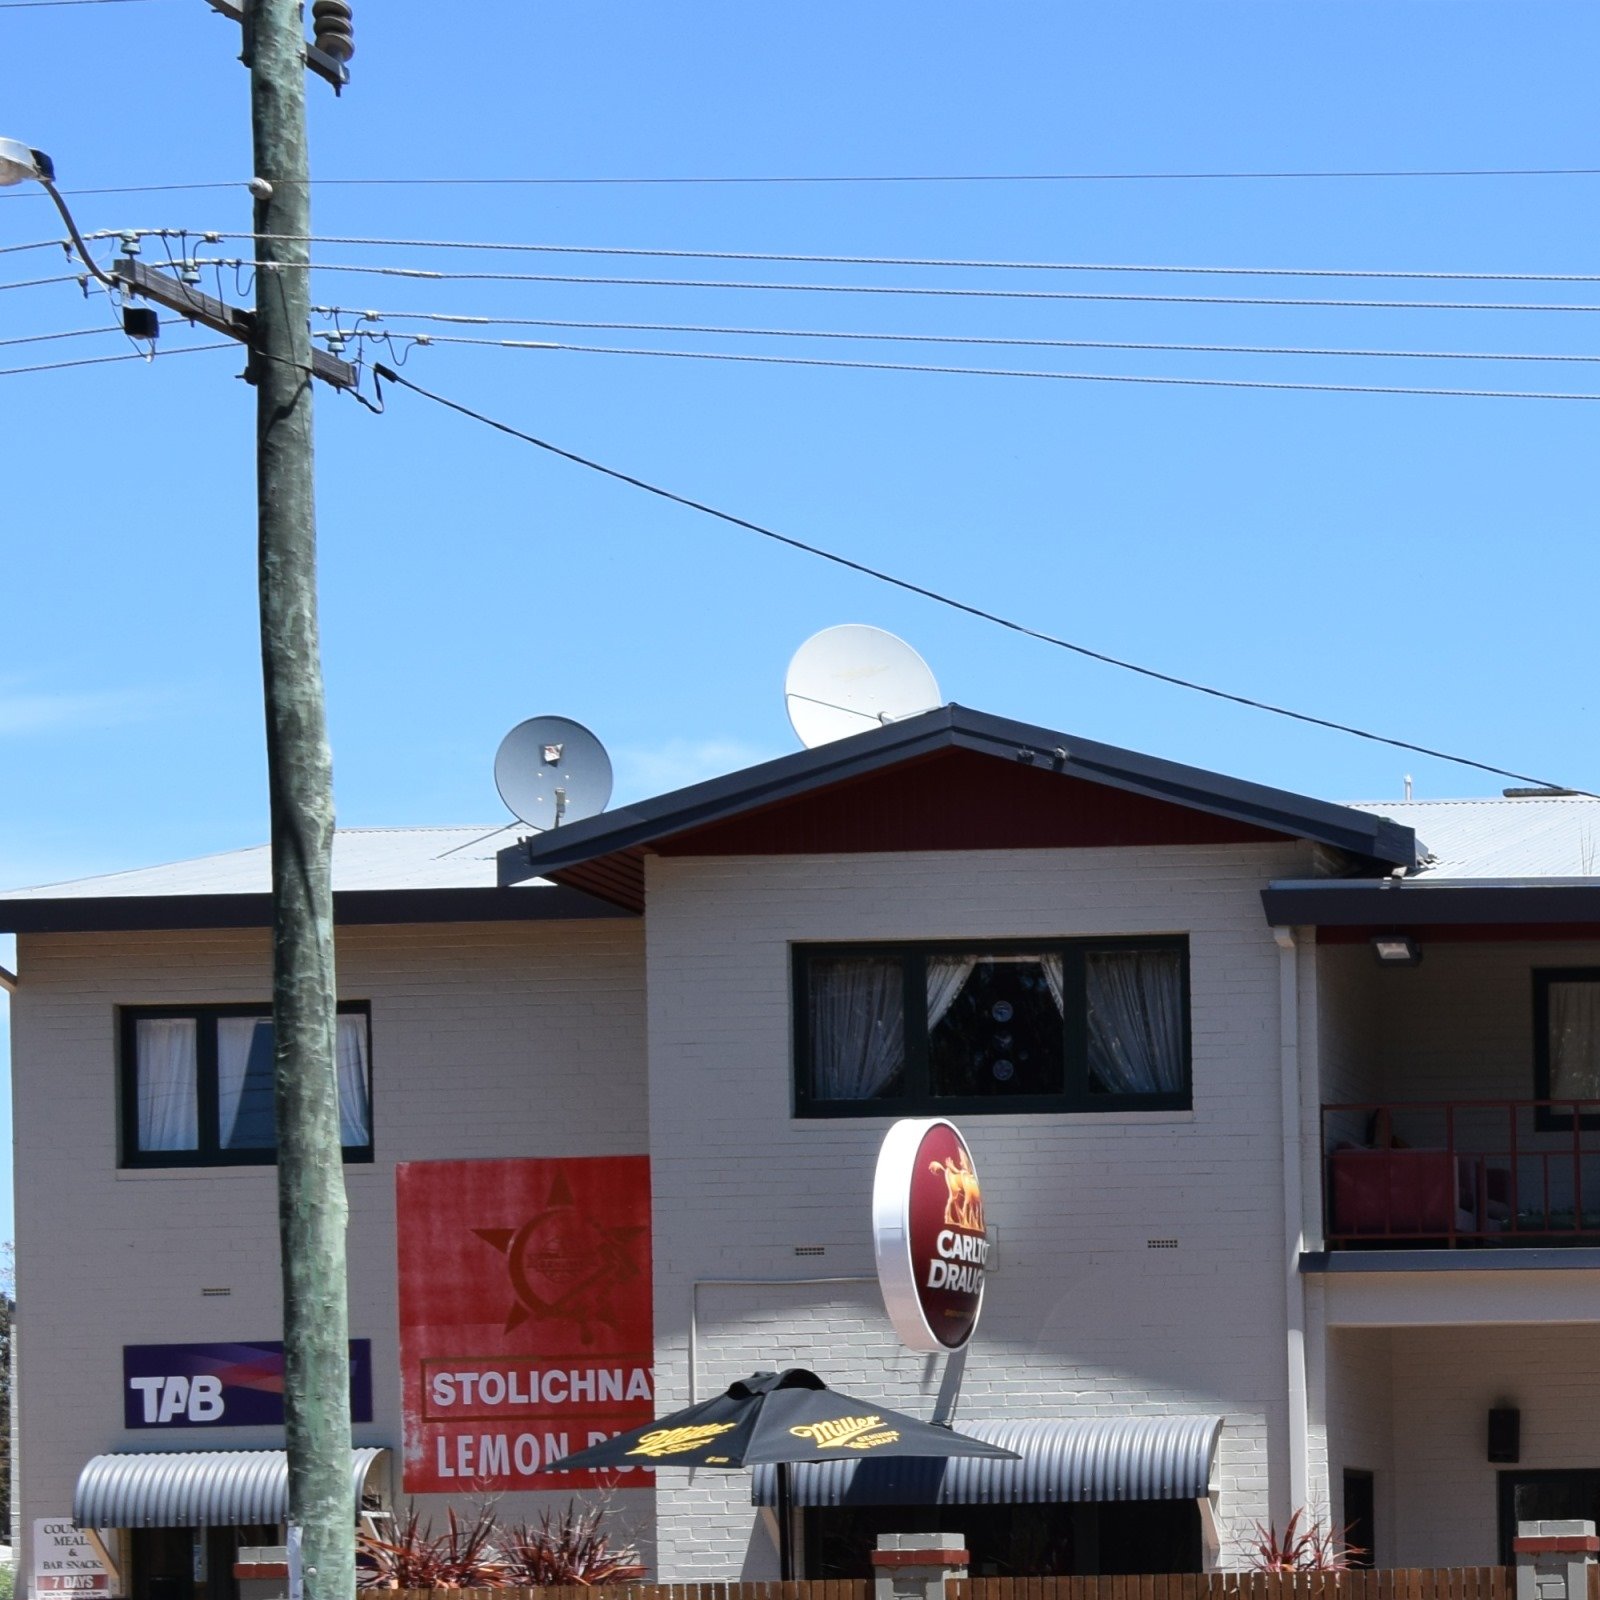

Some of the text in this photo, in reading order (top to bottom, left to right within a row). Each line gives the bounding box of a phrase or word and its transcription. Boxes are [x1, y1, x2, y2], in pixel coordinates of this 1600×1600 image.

[937, 1229, 990, 1264] CARLTO
[130, 1375, 225, 1423] TAB
[790, 1416, 887, 1448] Miller
[437, 1432, 569, 1477] LEMON
[43, 1561, 63, 1570] BAR
[68, 1548, 78, 1557] &
[52, 1575, 94, 1589] 7 DAYS
